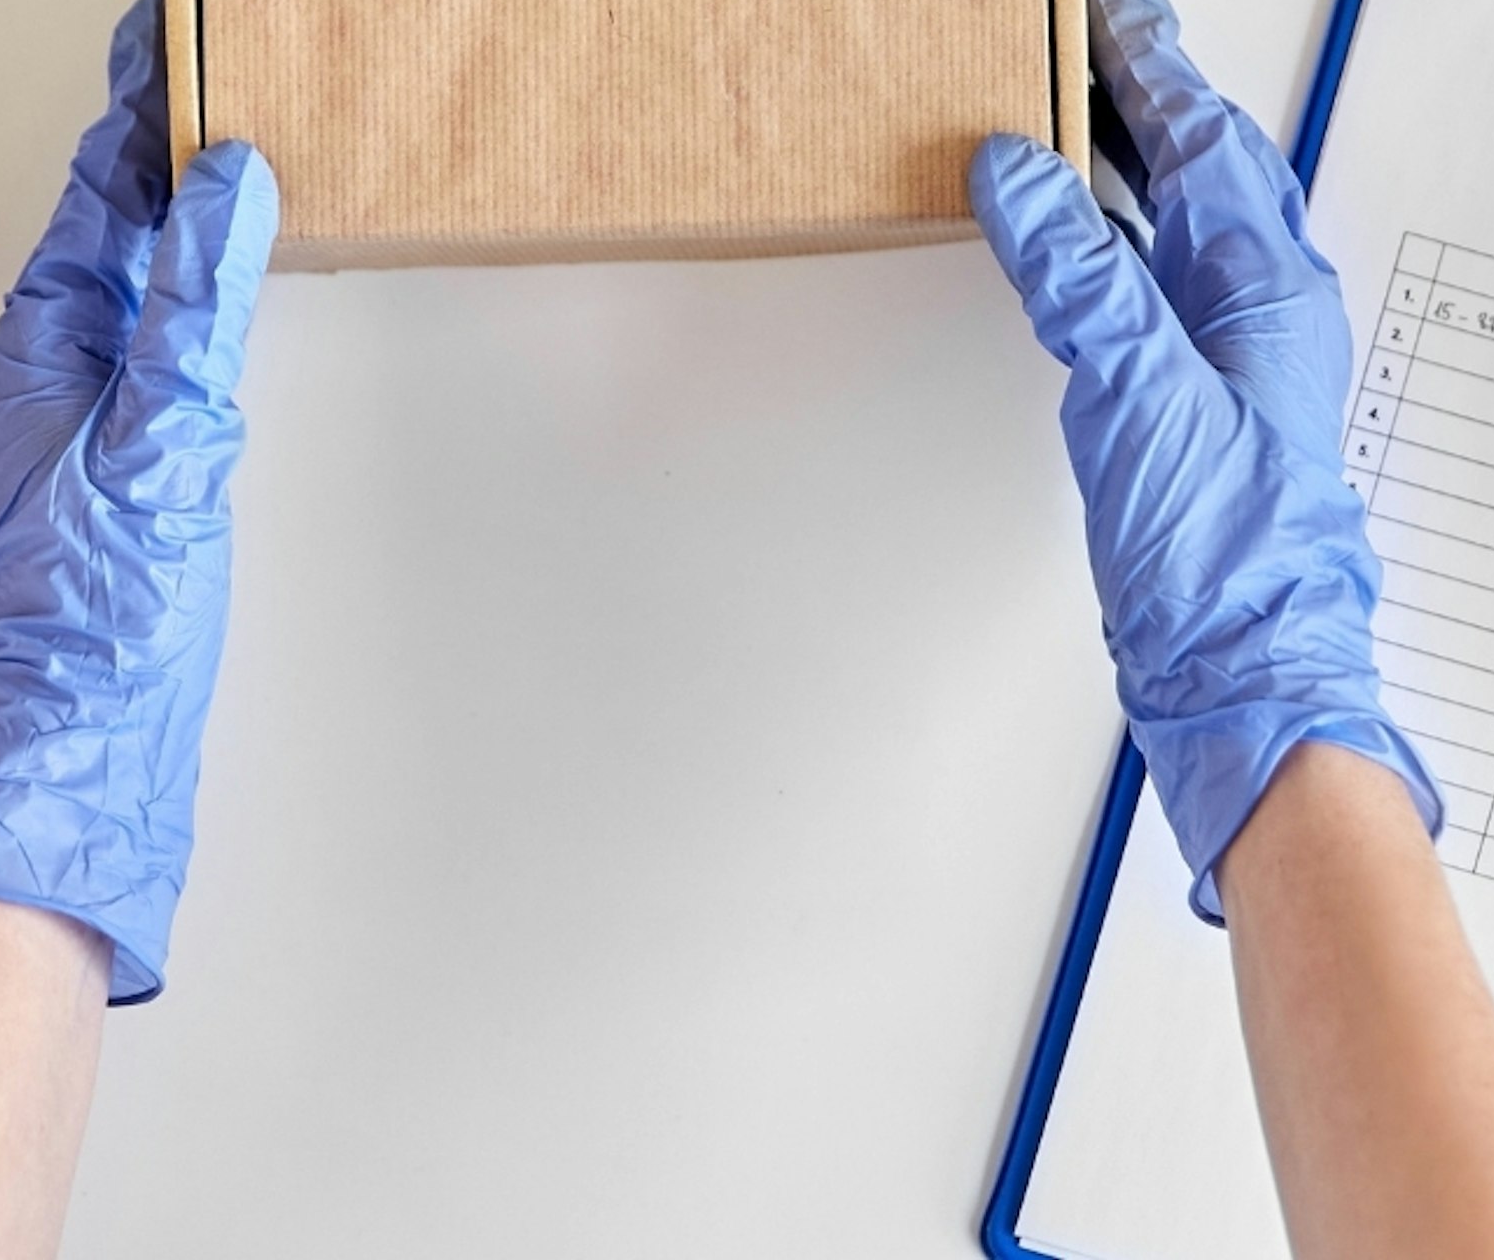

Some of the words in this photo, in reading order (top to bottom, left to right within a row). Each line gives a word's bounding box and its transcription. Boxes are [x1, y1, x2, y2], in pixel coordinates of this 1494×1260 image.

[1404, 289, 1414, 302] 1.
[1390, 327, 1403, 342] 2.
[1379, 366, 1392, 381] 3.
[1367, 407, 1380, 421] 4.
[1358, 444, 1370, 458] 5.
